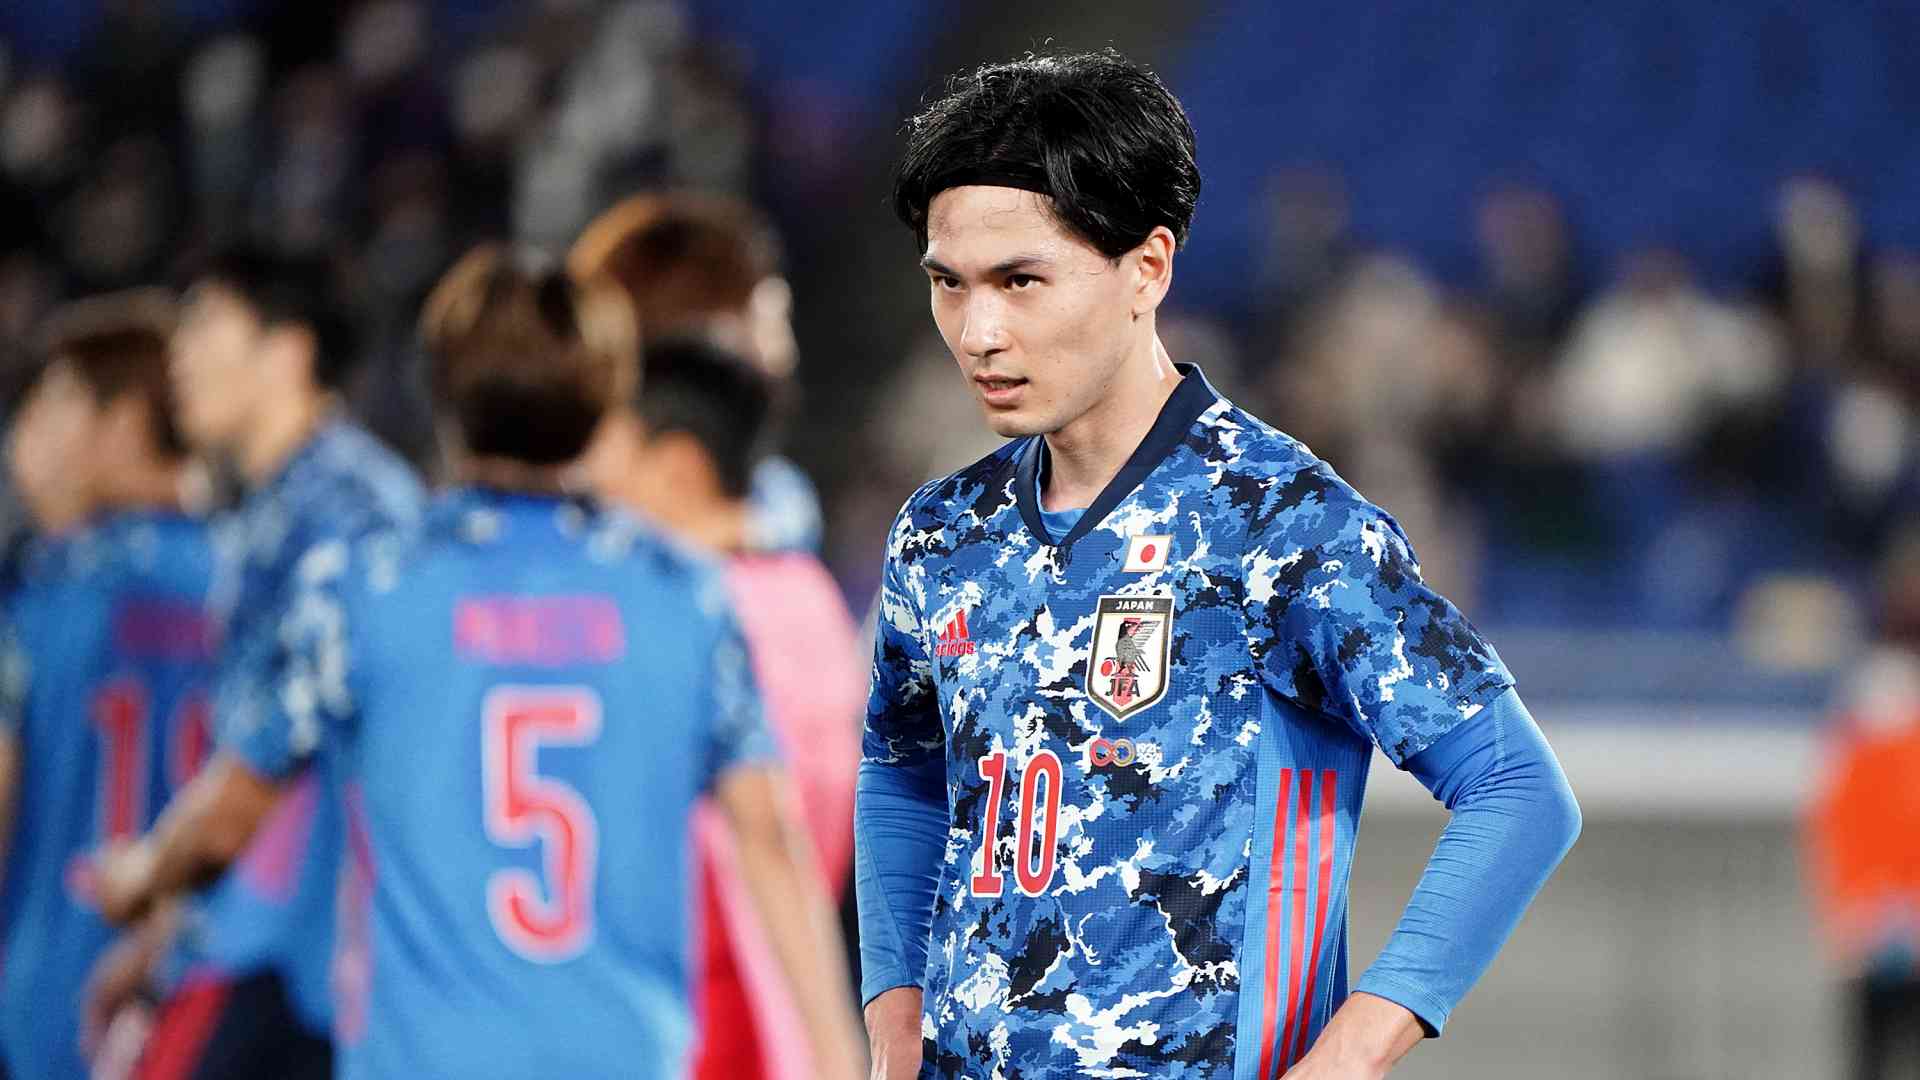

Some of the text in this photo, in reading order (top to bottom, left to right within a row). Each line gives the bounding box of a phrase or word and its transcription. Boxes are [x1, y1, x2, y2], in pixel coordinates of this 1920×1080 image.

[1116, 600, 1154, 610] JAPAN
[1105, 678, 1140, 697] JFA
[483, 686, 602, 960] 5
[971, 750, 1063, 898] 10
